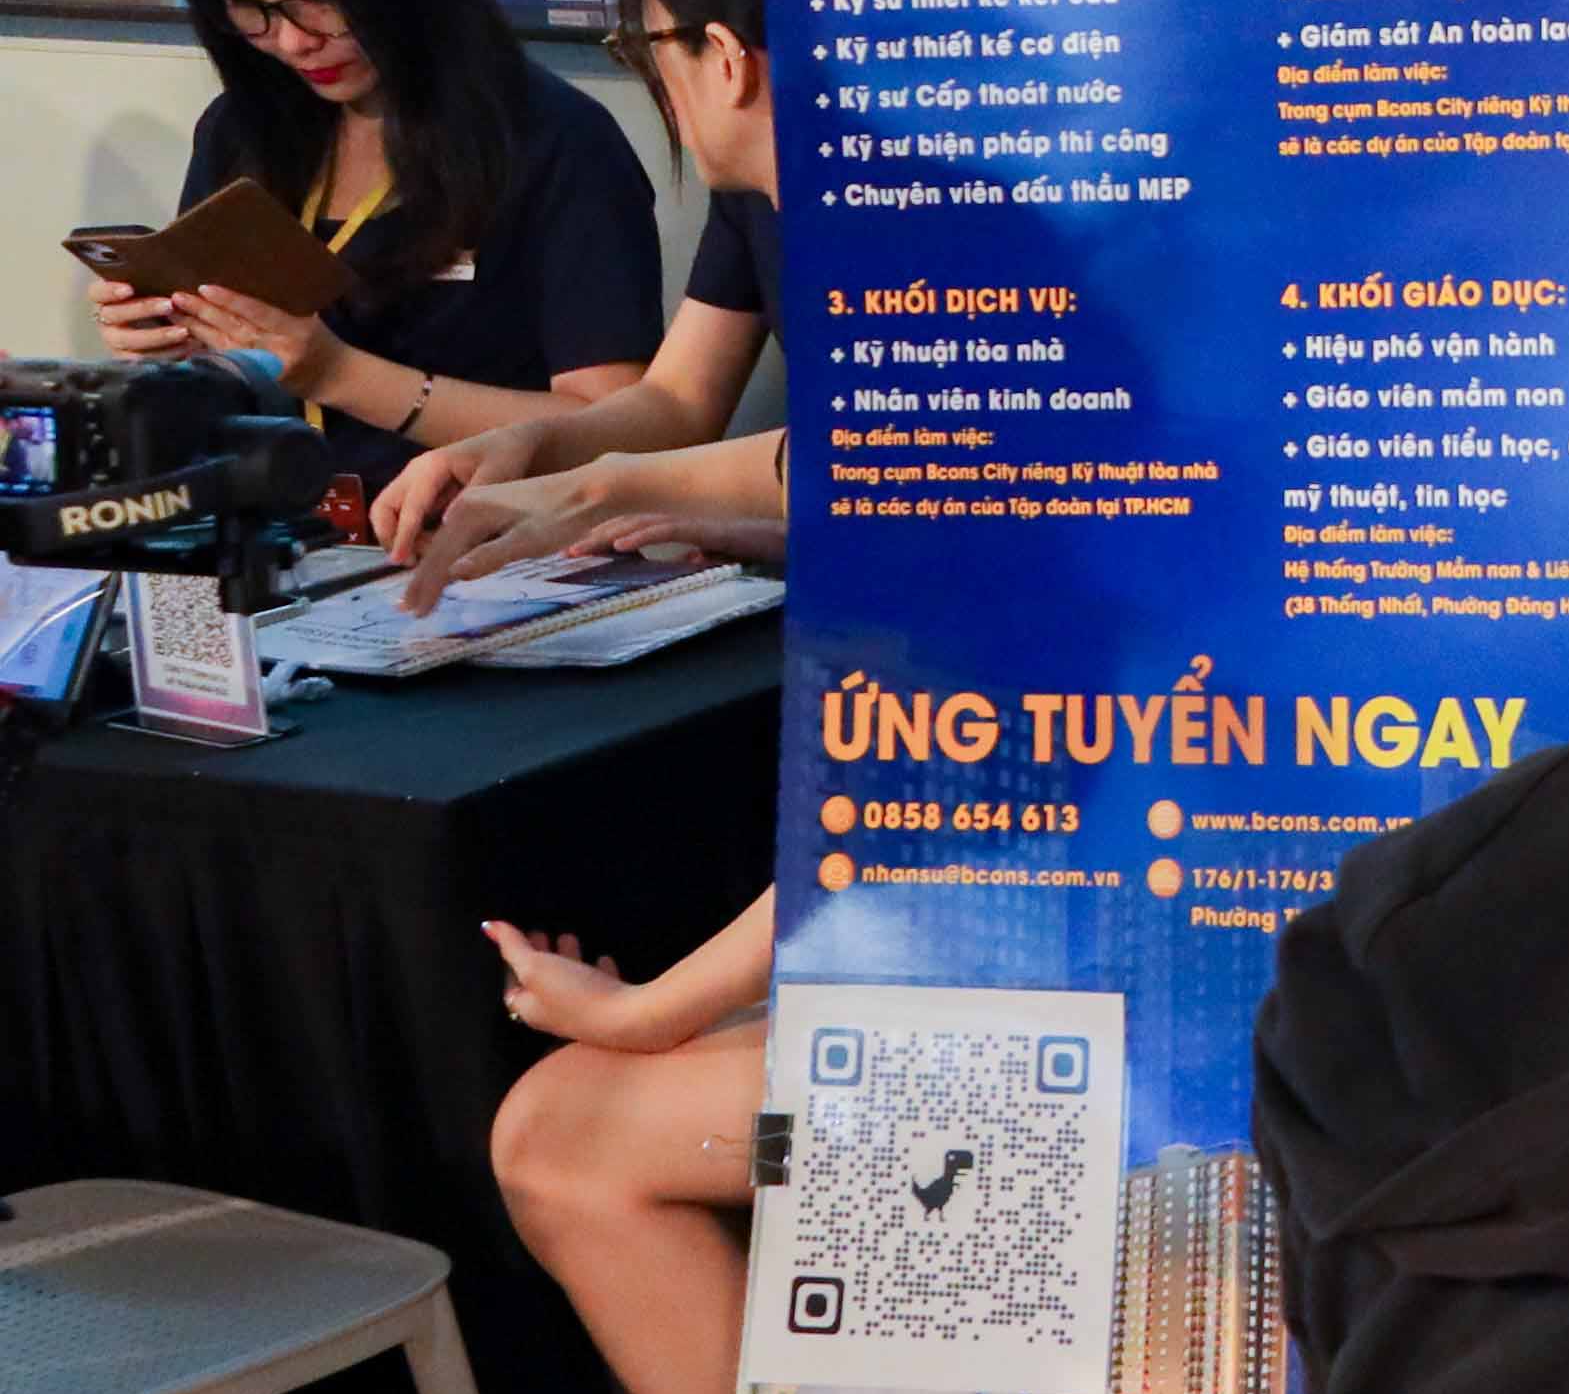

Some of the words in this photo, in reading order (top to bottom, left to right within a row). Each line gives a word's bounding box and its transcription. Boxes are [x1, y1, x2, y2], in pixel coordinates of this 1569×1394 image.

[839, 84, 870, 114] Kỹ
[878, 83, 910, 109] sư
[915, 78, 971, 111] Cấp
[979, 80, 1048, 106] thoát
[1056, 79, 1123, 104] nước
[827, 290, 855, 316] 3.
[864, 278, 937, 315] KHỐI
[946, 287, 1019, 321] DỊCH
[1029, 287, 1078, 319] VỤ:
[1280, 283, 1309, 309] 4.
[1319, 272, 1393, 309] KHỐI
[1402, 274, 1483, 308] GIÁO
[1492, 279, 1568, 314] DỤC:
[59, 483, 191, 538] RONIN
[821, 670, 1000, 763] ỨNG
[1022, 654, 1266, 766] TUYỂN
[1296, 696, 1527, 770] NGAY
[863, 802, 942, 830] 0858
[952, 803, 1013, 833] 654
[1021, 804, 1080, 833] 613
[862, 862, 1120, 891] nhansu@bcons.com.vn
[1191, 905, 1276, 934] Phường
